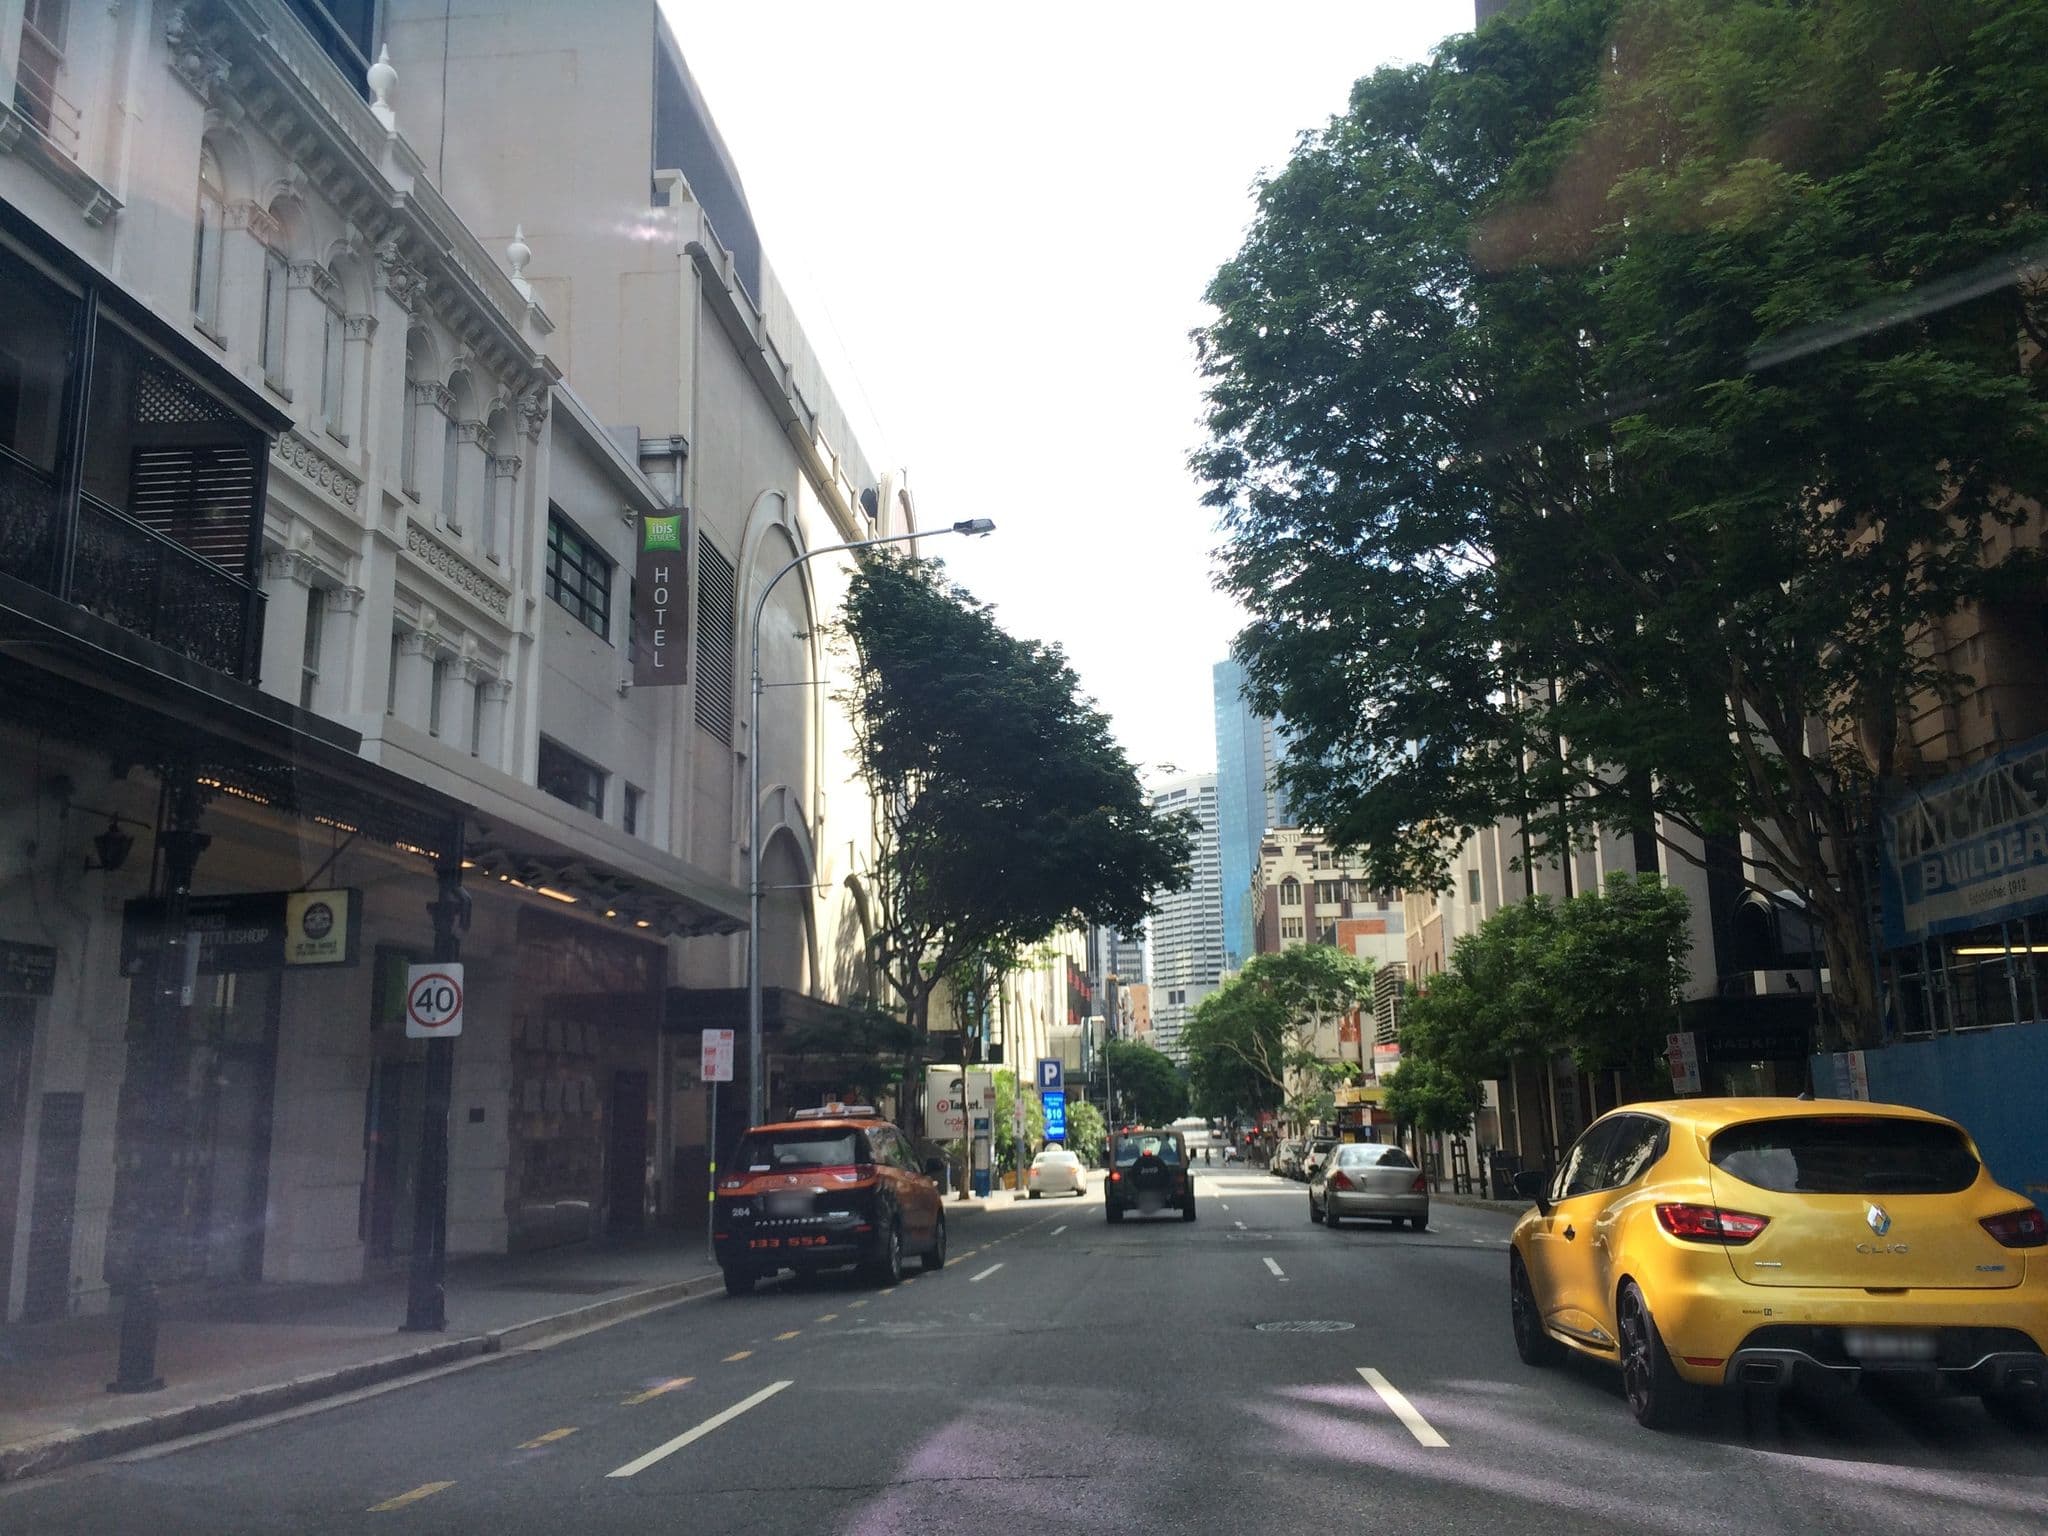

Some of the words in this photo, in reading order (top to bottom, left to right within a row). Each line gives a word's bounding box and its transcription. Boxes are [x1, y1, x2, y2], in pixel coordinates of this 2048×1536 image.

[652, 522, 673, 534] ibis
[654, 567, 668, 668] HOTEL
[415, 987, 454, 1013] 40
[1712, 1036, 1801, 1050] JACKPT
[1044, 1063, 1058, 1086] P
[1856, 1243, 1909, 1254] CLIO
